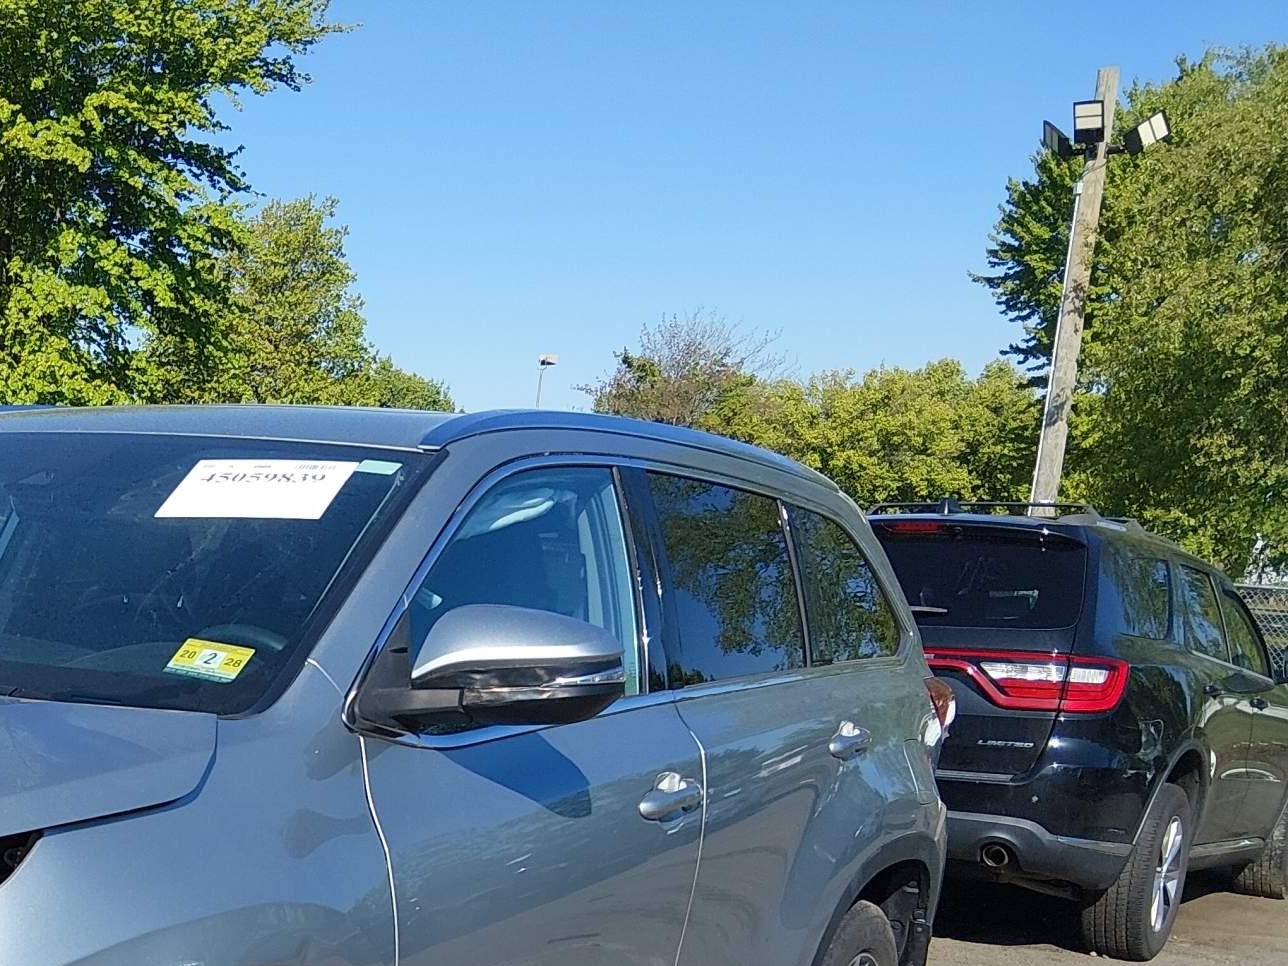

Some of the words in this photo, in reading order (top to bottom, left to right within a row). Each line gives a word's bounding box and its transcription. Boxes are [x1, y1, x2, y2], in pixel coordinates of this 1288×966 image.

[179, 649, 197, 660] 20
[203, 652, 218, 665] 2
[223, 657, 243, 668] 28
[977, 739, 1034, 748] LIMITED
